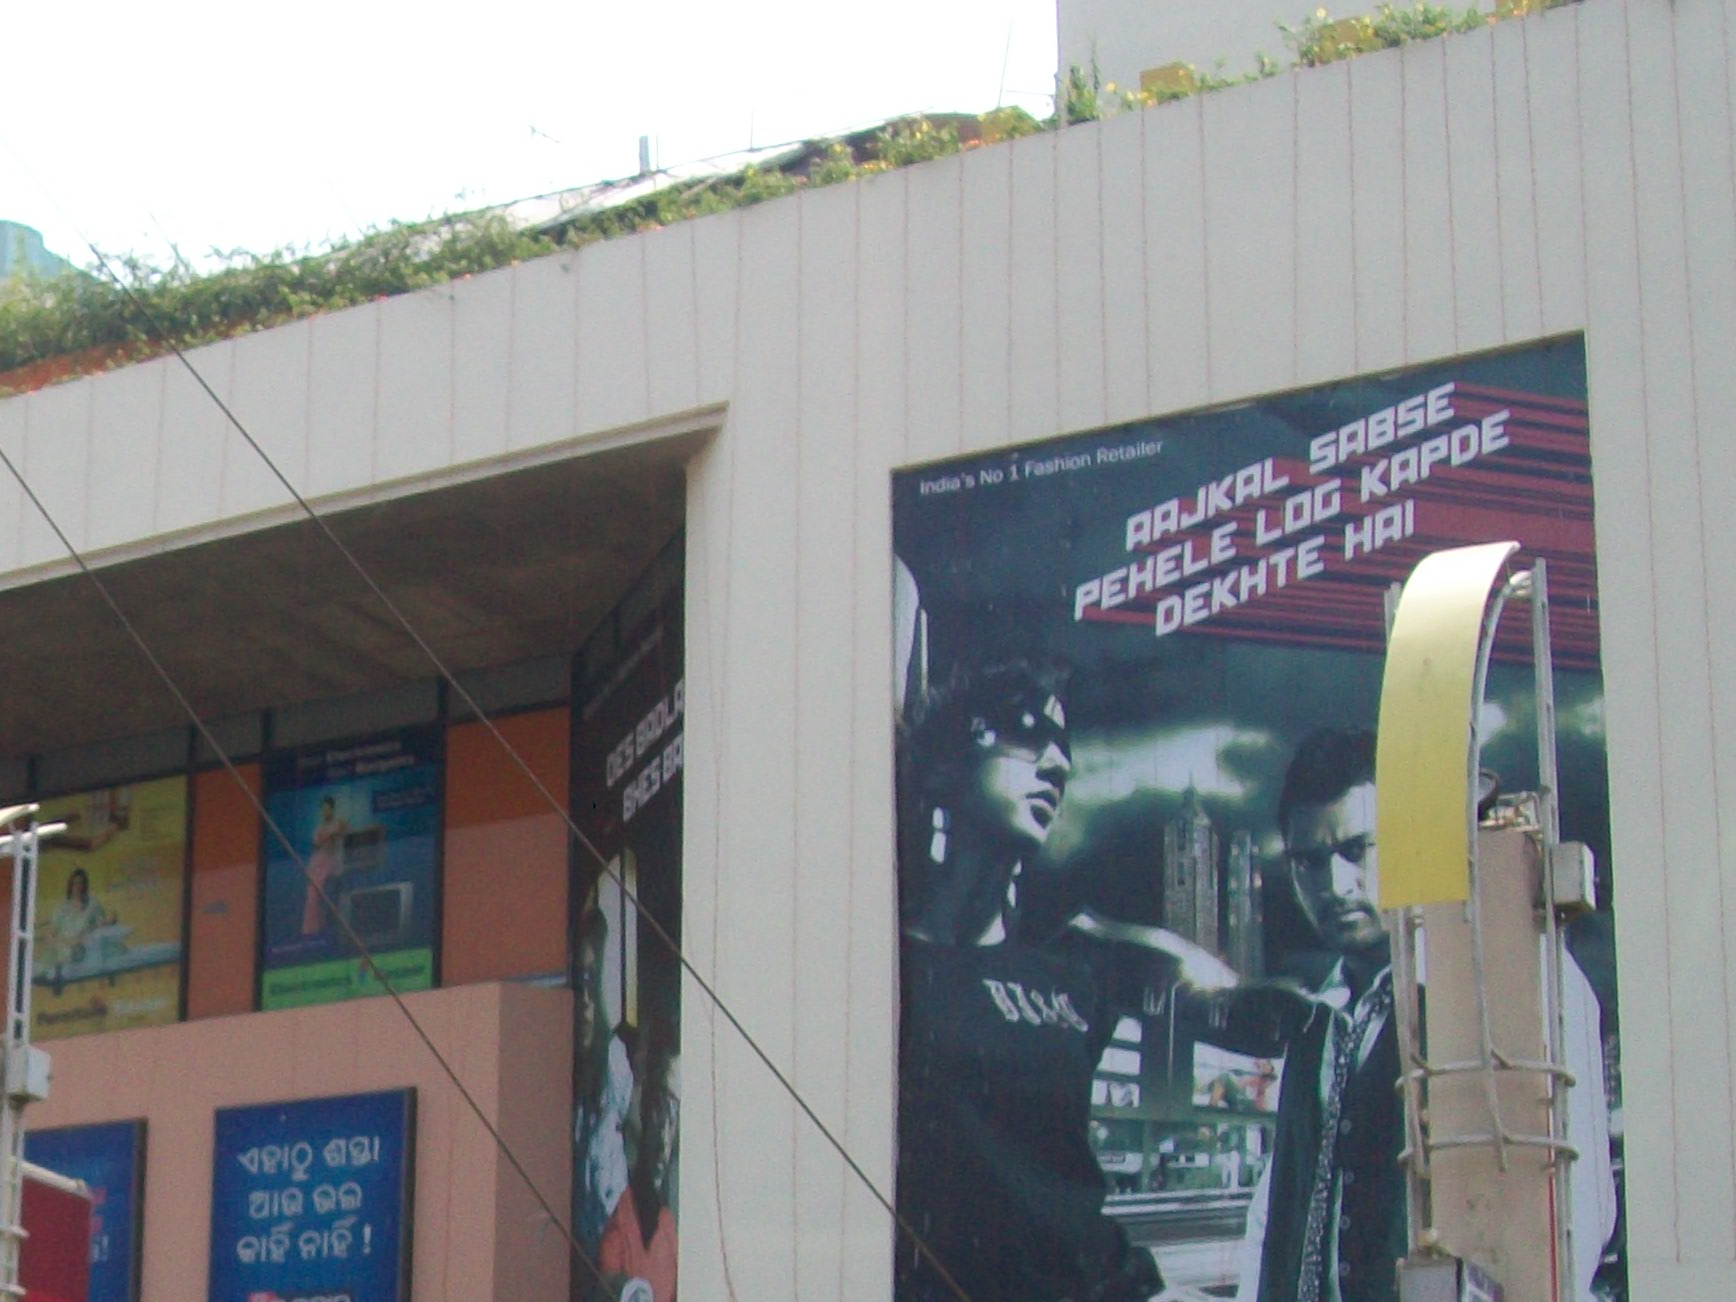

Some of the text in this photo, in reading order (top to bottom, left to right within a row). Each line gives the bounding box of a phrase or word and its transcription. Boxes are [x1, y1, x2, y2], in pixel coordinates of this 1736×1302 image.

[920, 440, 1163, 496] India's No 1 Fashion Retailer
[1074, 410, 1511, 623] PEHELE LOG KAPDE
[1125, 382, 1456, 552] AAJKAL SABSE
[1155, 499, 1415, 637] DEKHTE HAI
